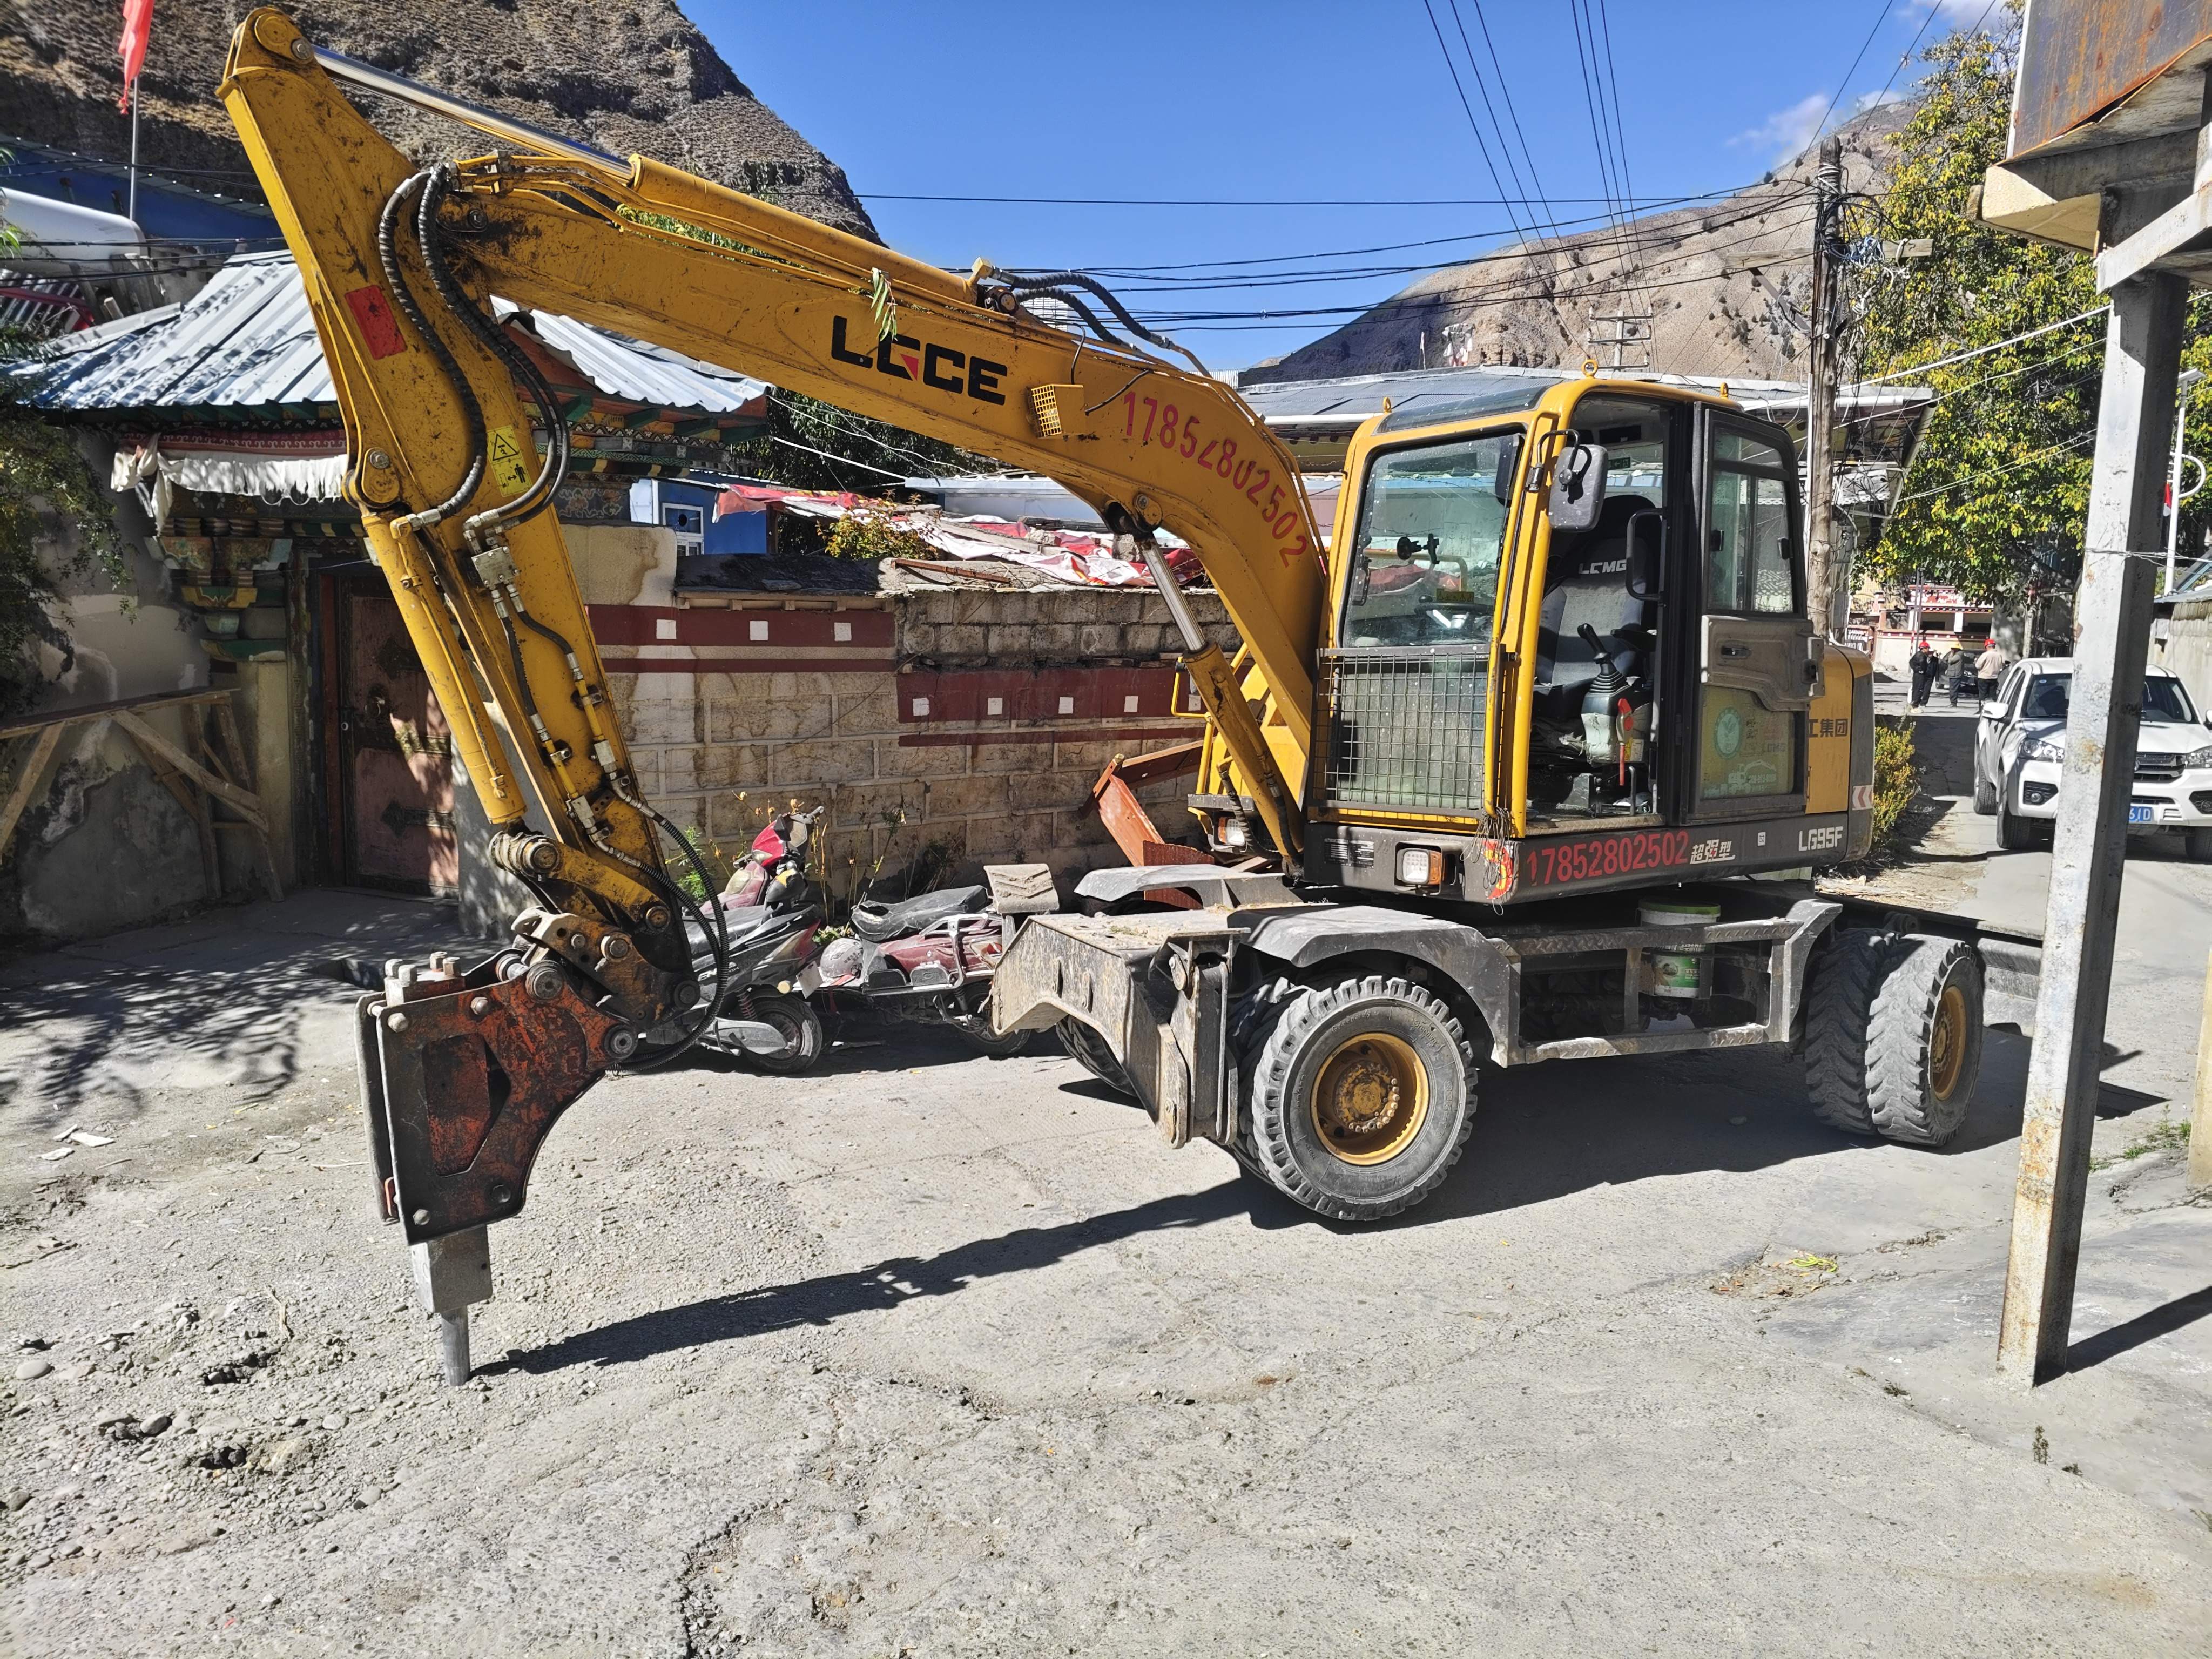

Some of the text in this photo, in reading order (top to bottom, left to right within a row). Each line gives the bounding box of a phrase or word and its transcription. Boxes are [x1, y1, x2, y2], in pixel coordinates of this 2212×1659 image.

[1808, 718, 1848, 738] 工集团
[1690, 839, 1736, 865] 超强型
[1798, 826, 1843, 852] LG95F
[1527, 831, 1689, 886] 17852802502
